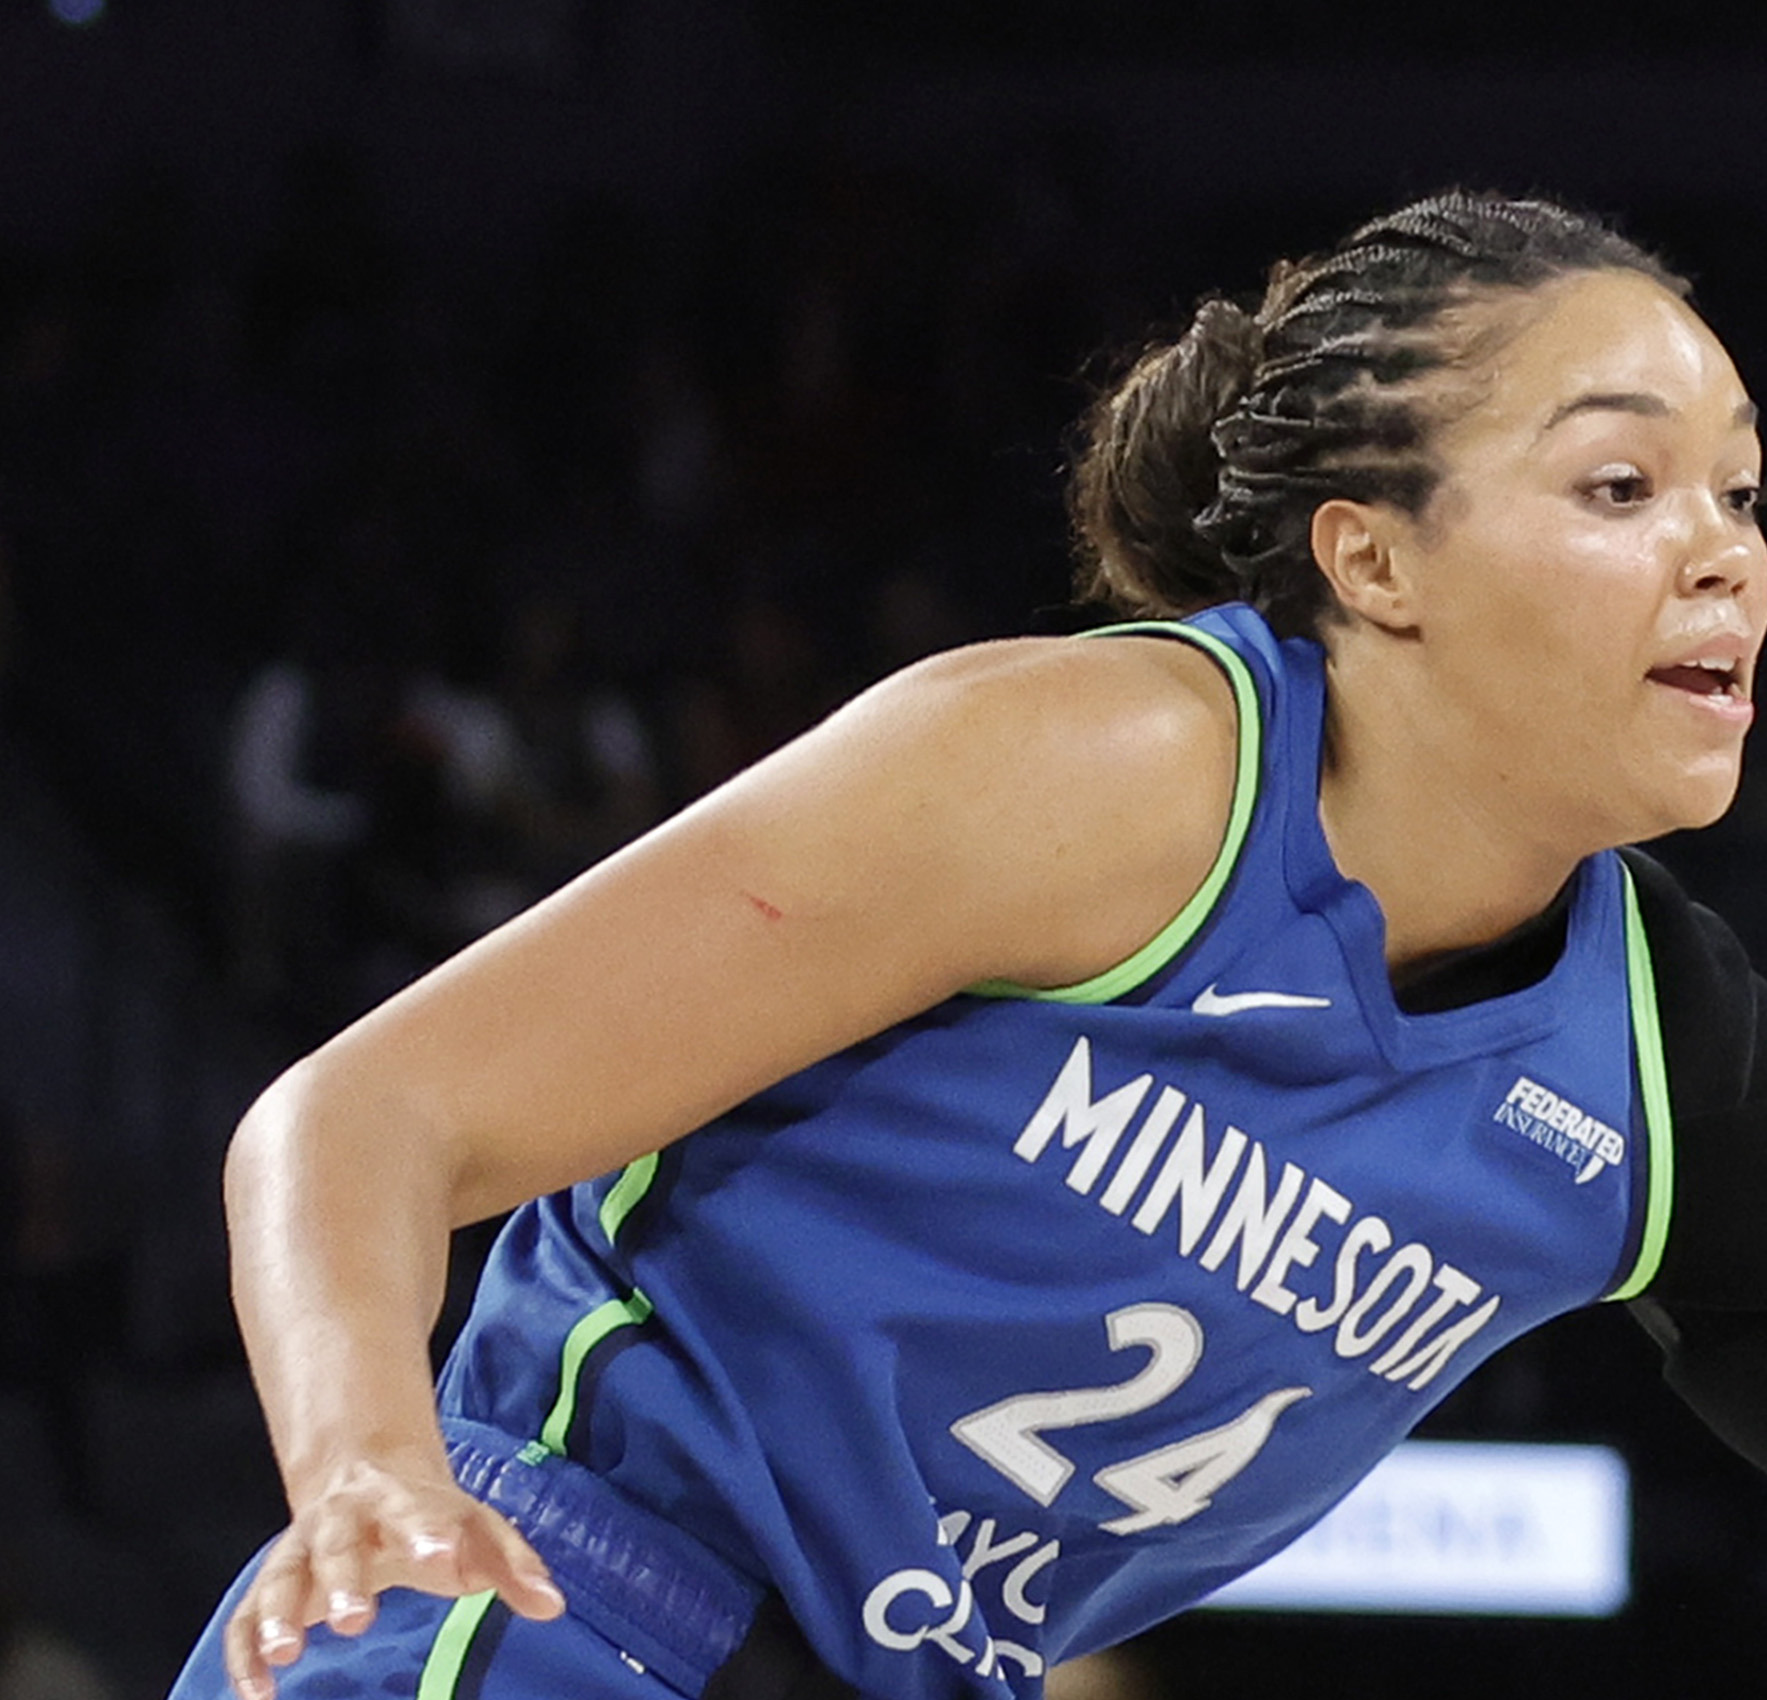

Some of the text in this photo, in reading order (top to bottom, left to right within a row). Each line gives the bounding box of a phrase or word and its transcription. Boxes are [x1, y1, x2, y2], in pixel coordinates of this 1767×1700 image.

[1012, 1035, 1501, 1391] MINNESOTA
[1505, 1075, 1625, 1167] FEDERATED
[949, 1300, 1313, 1537] 24
